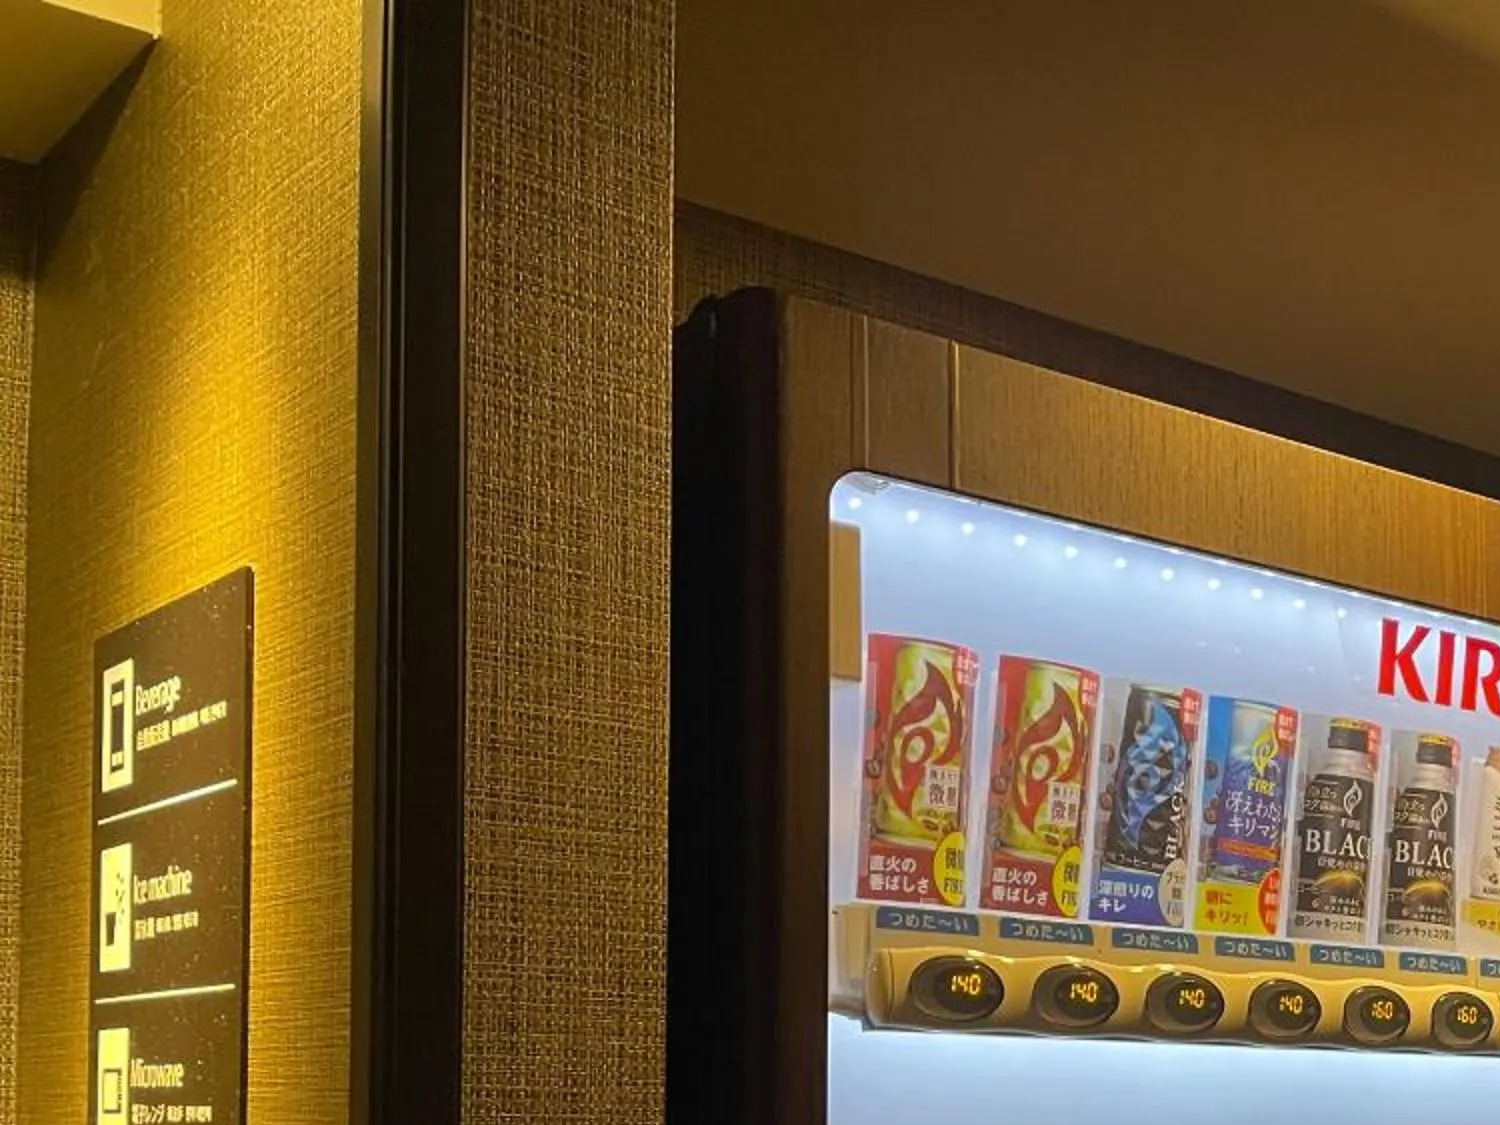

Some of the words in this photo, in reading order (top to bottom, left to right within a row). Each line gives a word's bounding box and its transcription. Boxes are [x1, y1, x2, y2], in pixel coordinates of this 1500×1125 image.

[135, 674, 182, 717] Beverage
[868, 855, 918, 874] 直火の
[149, 865, 193, 902] machine
[868, 873, 930, 896] 香ばしさ
[991, 866, 1038, 886] 直火の
[991, 884, 1049, 907] 香ばしさ
[1097, 896, 1128, 914] キレ
[951, 973, 982, 996] 140
[1069, 981, 1099, 1003] 140
[1179, 988, 1206, 1009] 140
[1279, 995, 1304, 1015] 140
[1456, 1005, 1479, 1025] 160
[129, 1058, 185, 1090] Microwave
